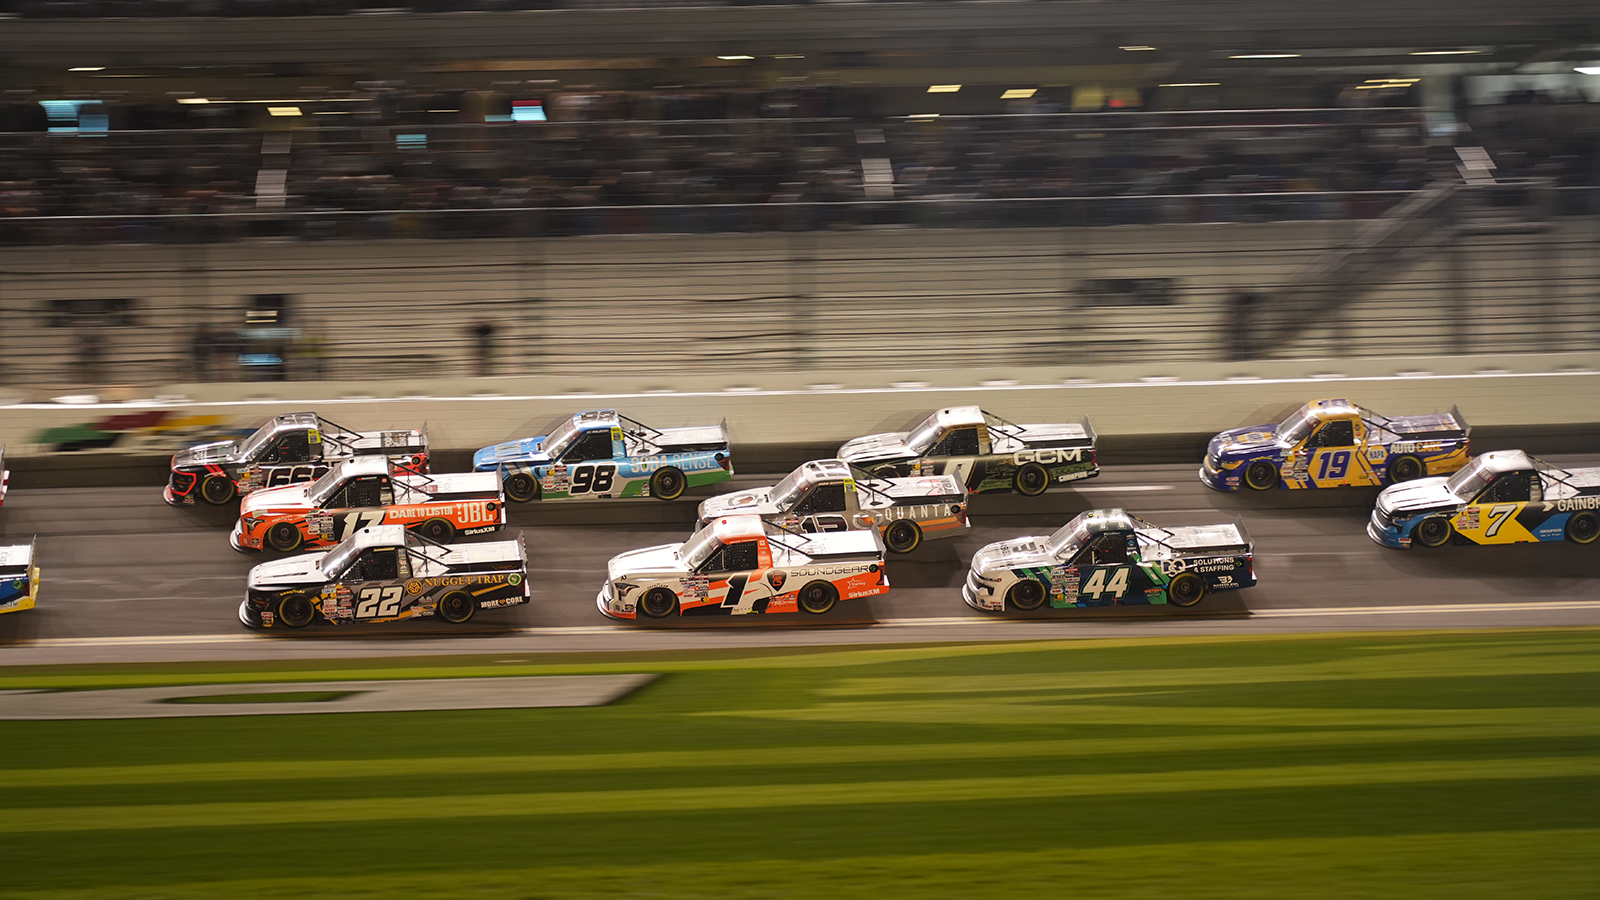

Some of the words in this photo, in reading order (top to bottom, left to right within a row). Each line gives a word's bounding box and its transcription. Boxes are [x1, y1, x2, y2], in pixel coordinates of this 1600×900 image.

[1368, 450, 1385, 460] NAPA
[1390, 443, 1415, 454] AUTO
[1416, 441, 1443, 452] CARE
[631, 455, 669, 473] SODA
[1013, 449, 1082, 466] GCM
[1317, 450, 1352, 480] 19
[570, 463, 617, 495] 98
[389, 508, 416, 519] DARE
[417, 508, 425, 517] TO
[426, 505, 453, 516] LISTEN
[457, 501, 493, 524] JBL
[885, 504, 951, 523] QUANTA
[1485, 504, 1517, 537] 7
[340, 511, 387, 542] 17
[464, 526, 495, 536] SiriusXM
[1193, 557, 1235, 566] SOLUTIONS
[1200, 564, 1235, 573] STAFFING
[790, 565, 869, 578] SOUNDGEAR
[425, 577, 473, 588] NUGGET
[476, 574, 504, 584] TRAP
[720, 571, 751, 608] 1
[1082, 567, 1130, 600] 44
[355, 586, 403, 618] 22
[480, 599, 500, 608] MORE
[505, 595, 524, 605] CORE
[848, 588, 880, 599] SiriusXM
